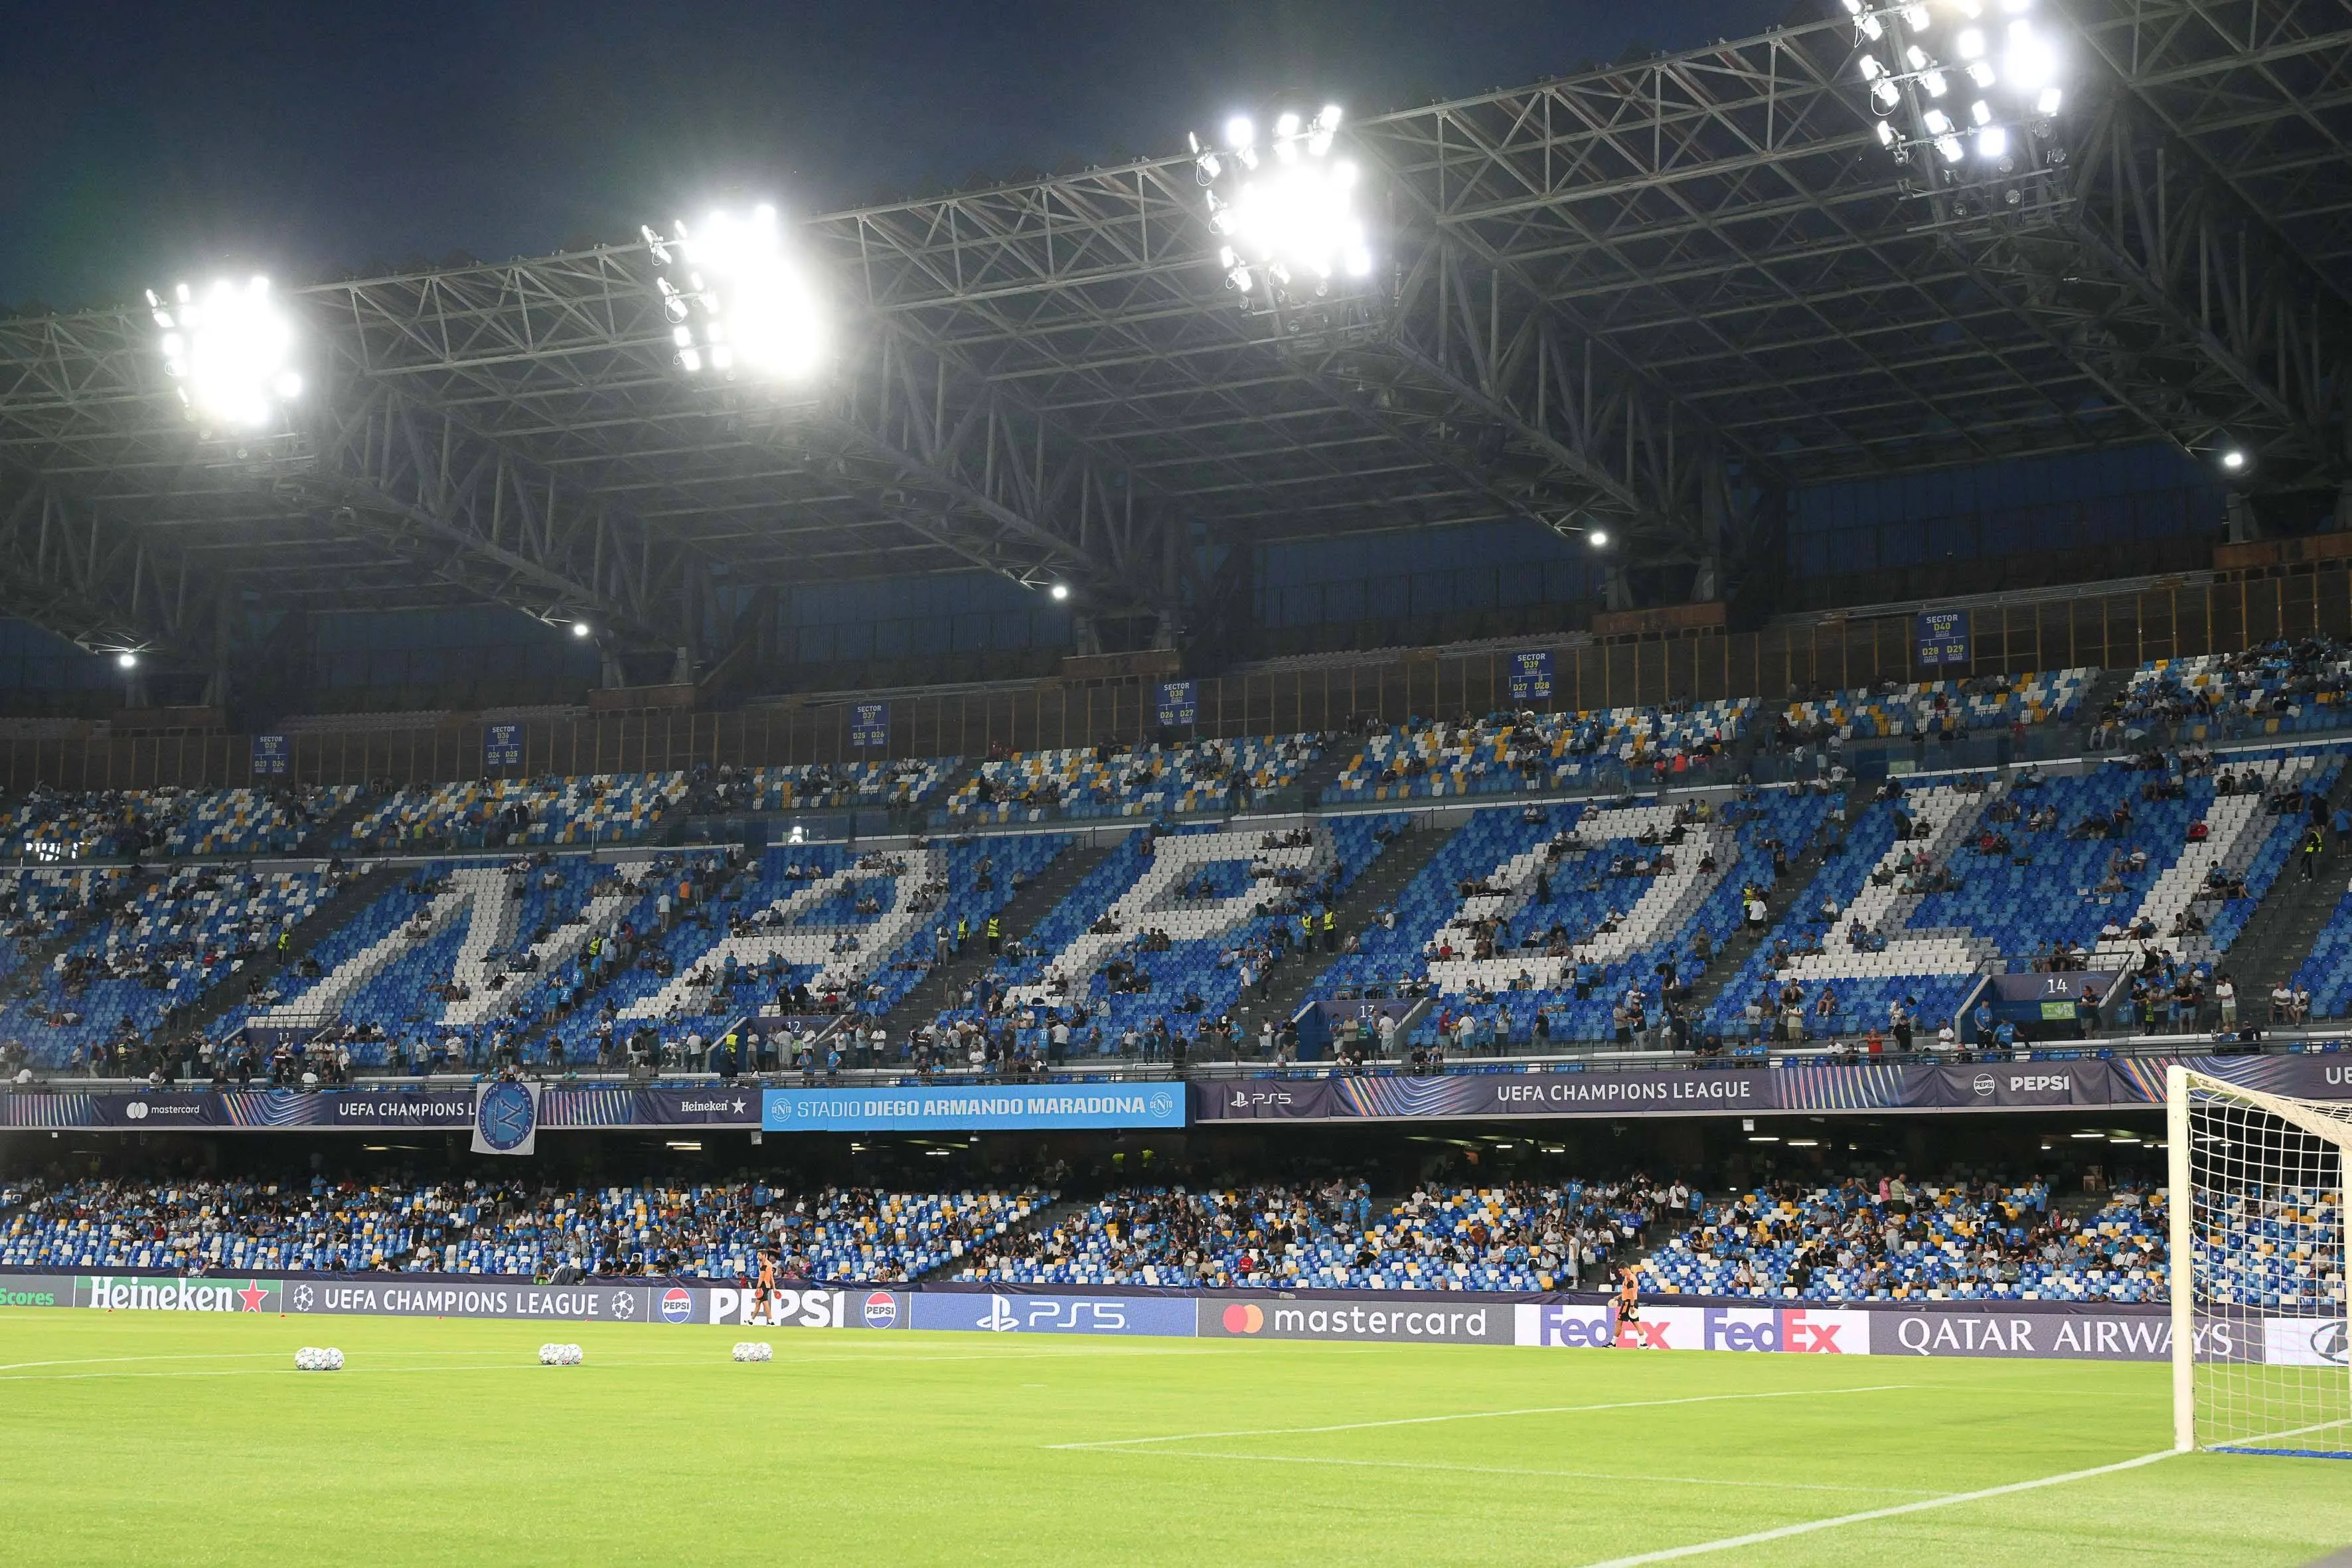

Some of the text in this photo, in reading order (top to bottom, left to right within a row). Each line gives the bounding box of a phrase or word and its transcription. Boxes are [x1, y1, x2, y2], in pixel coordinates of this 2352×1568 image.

[1926, 615, 1958, 623] SECTOR
[1922, 645, 1964, 656] D28 D29
[2047, 979, 2068, 993] 14
[787, 1021, 800, 1033] 12
[2010, 1075, 2070, 1091] PEPSI
[1498, 1081, 1751, 1101] UEFA CHAMPIONS LEAGUE
[681, 1101, 728, 1111] Heineken
[1252, 1093, 1291, 1105] PS5
[151, 1105, 199, 1115] mastercard
[339, 1103, 376, 1116] UEFA
[378, 1102, 465, 1117] CHAMPIONS
[797, 1097, 1146, 1118] STADIO DIEGO ARMANDO MARADONA
[1572, 1184, 1581, 1193] 10
[0, 1288, 54, 1306] Scores
[89, 1276, 234, 1312] Heineken
[325, 1289, 599, 1316] UEFA CHAMPIONS LEAGUE
[664, 1301, 689, 1310] PEPSI
[710, 1288, 844, 1328] PEPSI
[866, 1306, 894, 1315] PEPSI
[1029, 1301, 1126, 1329] PS5
[1275, 1306, 1486, 1336] mastercard
[1704, 1308, 1840, 1354] FedEx
[1898, 1318, 2035, 1356] QATAR
